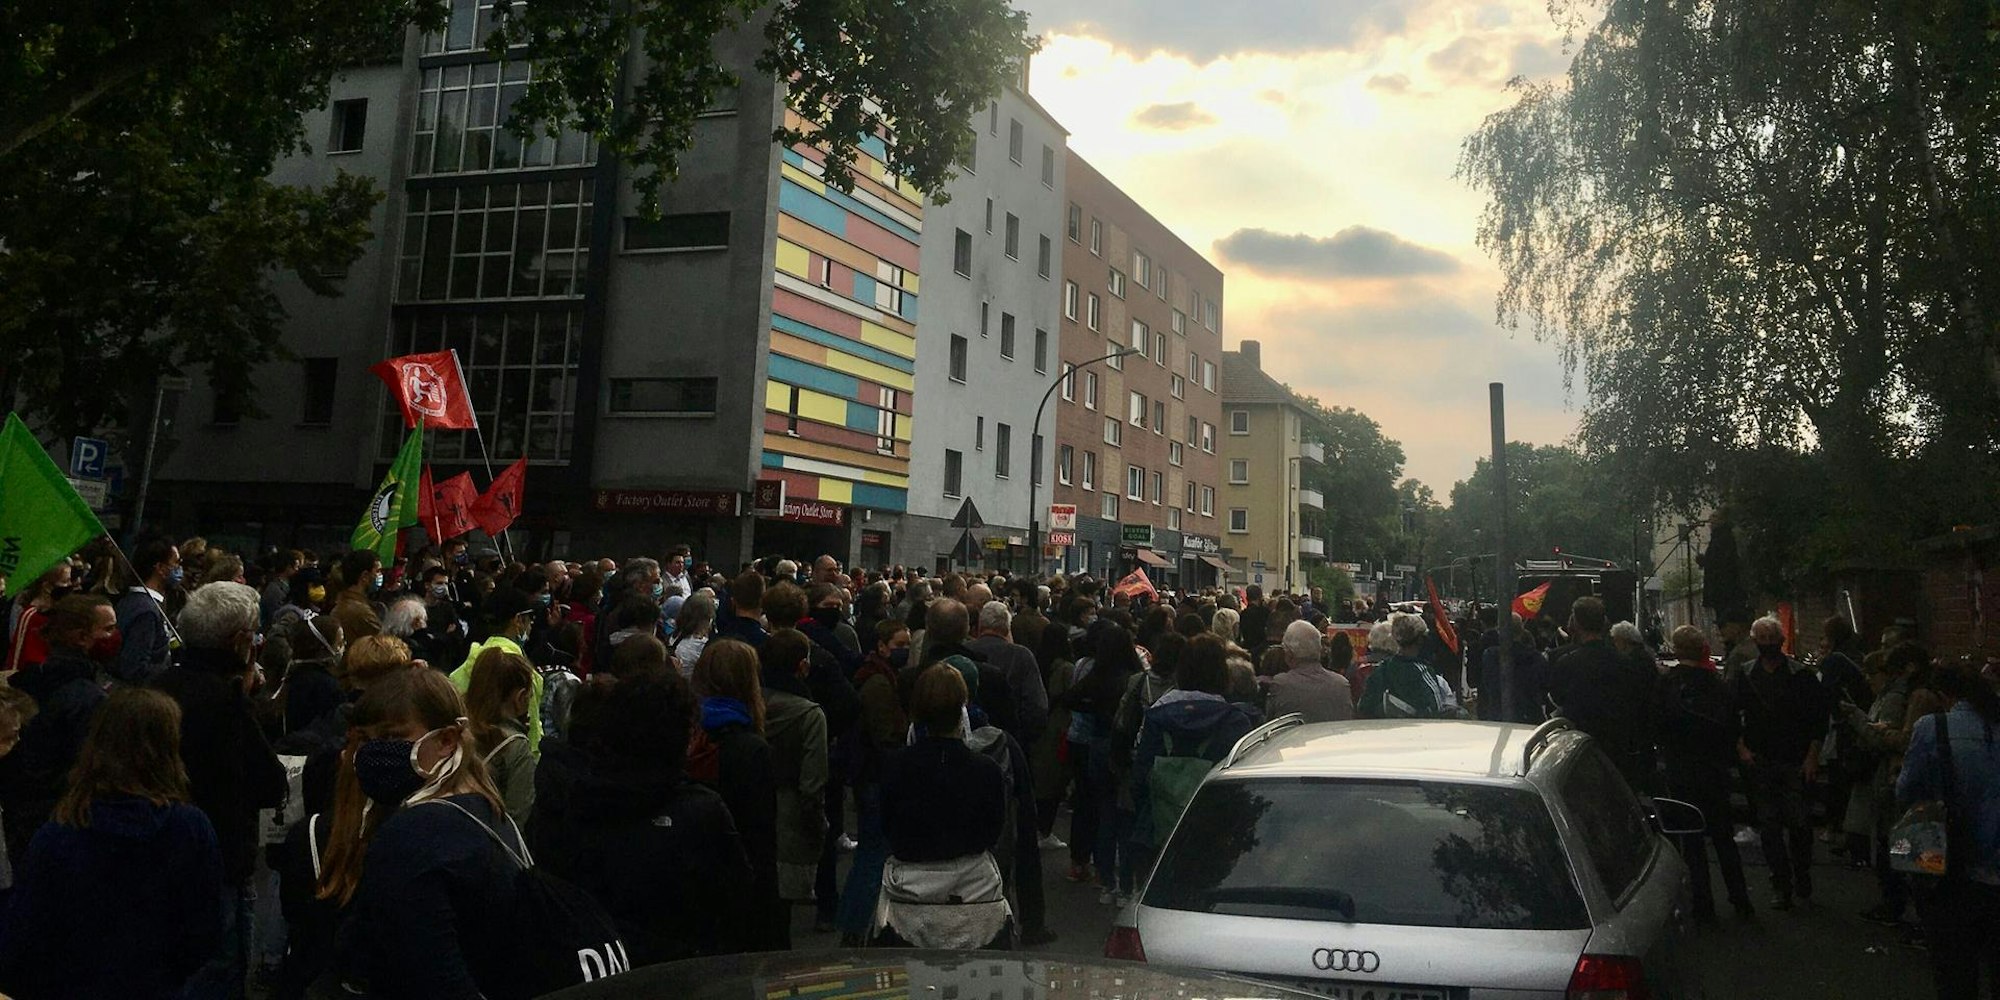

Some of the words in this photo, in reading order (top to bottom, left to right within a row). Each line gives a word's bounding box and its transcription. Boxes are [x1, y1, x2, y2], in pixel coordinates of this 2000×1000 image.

[77, 443, 98, 471] P
[616, 493, 651, 511] Factory
[653, 494, 682, 508] Outlet
[684, 494, 711, 508] Store
[802, 502, 819, 517] Outlet
[819, 505, 834, 519] Store
[1050, 533, 1073, 544] KIOSK
